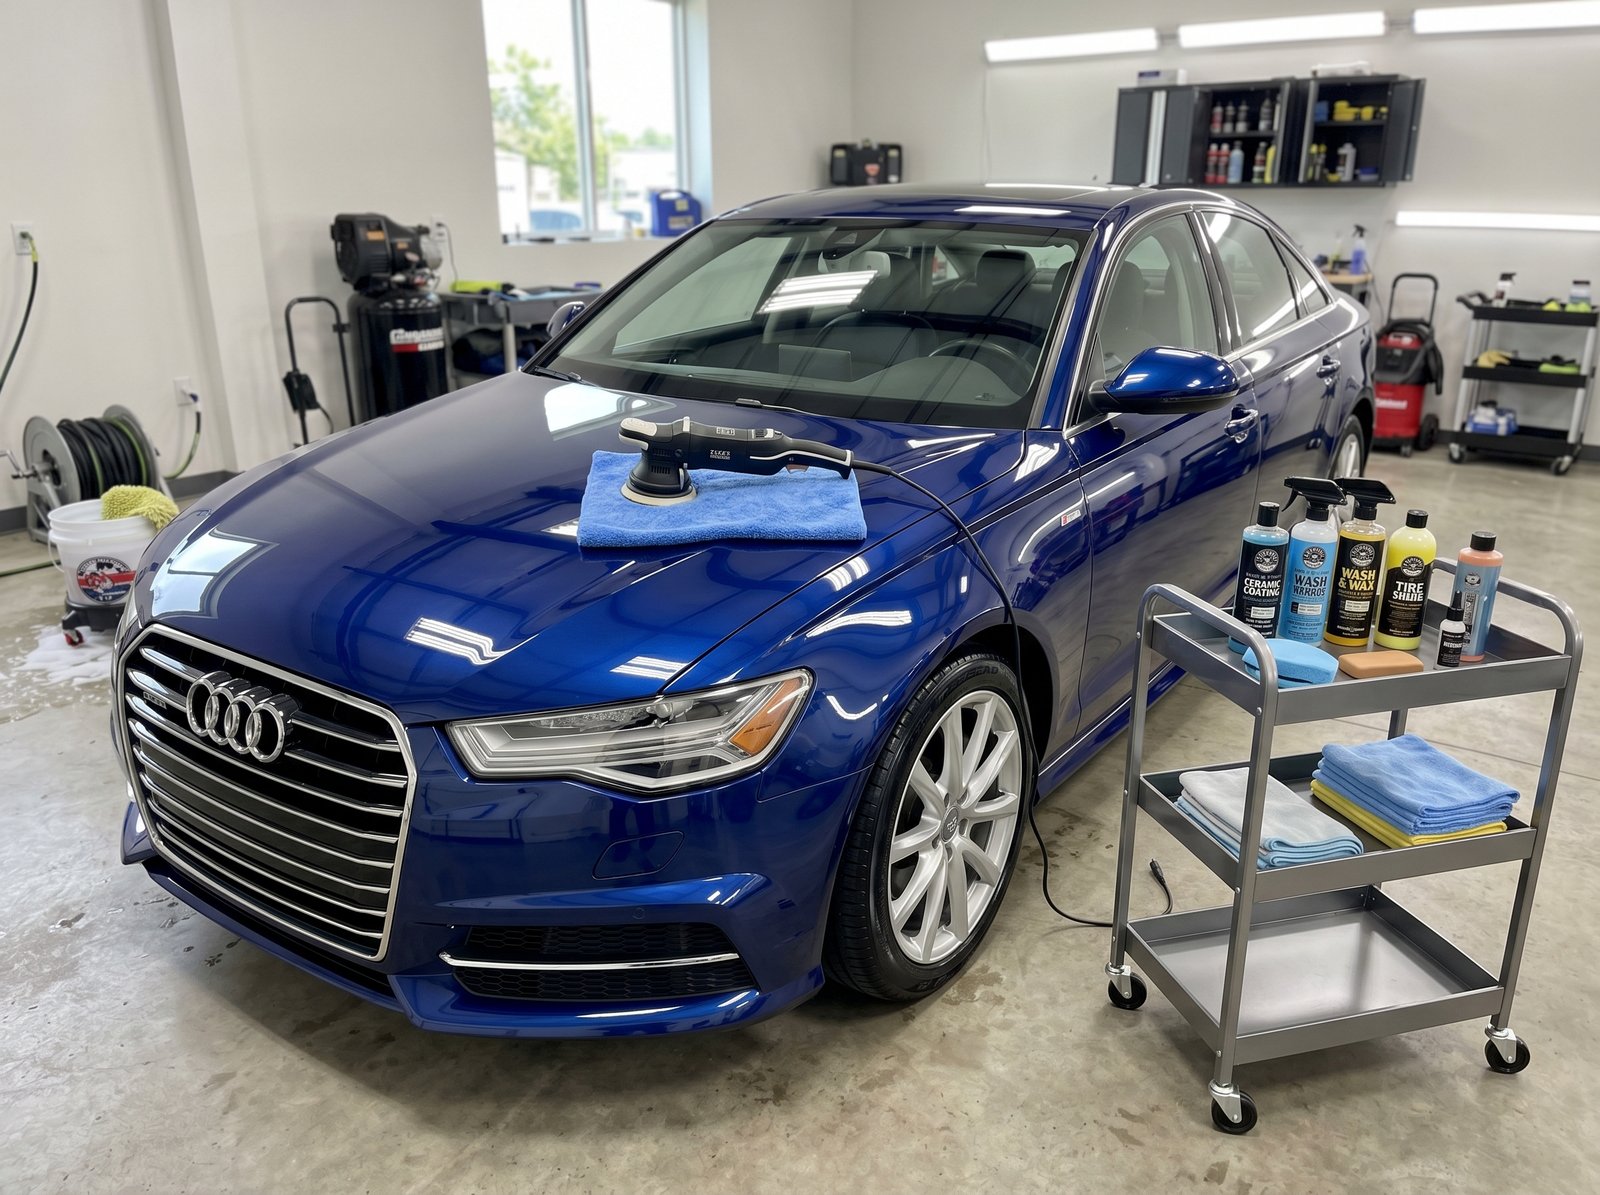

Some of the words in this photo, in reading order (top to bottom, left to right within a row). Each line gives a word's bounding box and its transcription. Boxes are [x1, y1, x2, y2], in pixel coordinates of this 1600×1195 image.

[1341, 567, 1376, 580] WASH
[1244, 577, 1281, 589] CERAMIC
[1294, 574, 1327, 587] WASH
[1338, 577, 1347, 589] &
[1348, 579, 1375, 591] WAX
[1243, 586, 1280, 597] COATING
[1395, 581, 1424, 593] TIRE
